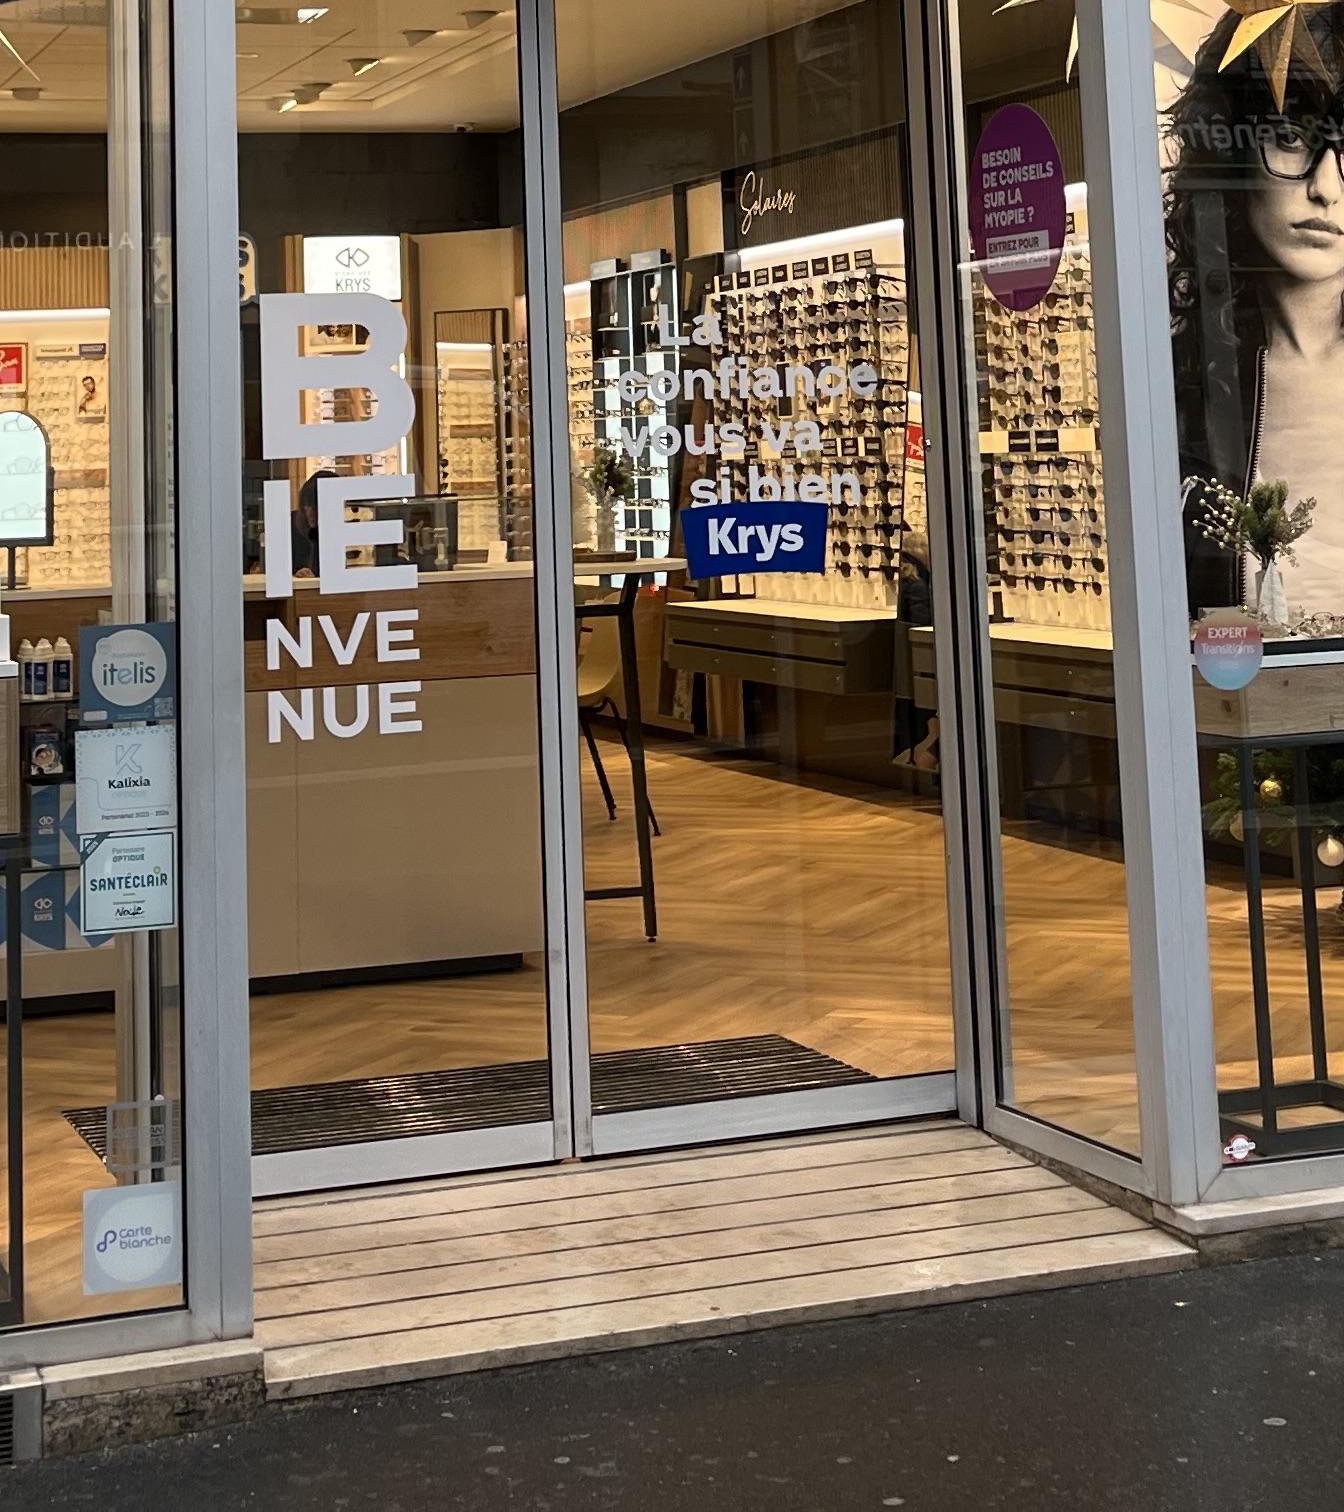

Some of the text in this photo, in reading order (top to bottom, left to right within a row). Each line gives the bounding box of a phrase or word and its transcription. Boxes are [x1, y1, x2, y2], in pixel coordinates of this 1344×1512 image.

[982, 146, 1021, 168] BESOIN
[983, 161, 1054, 188] DE CONSEILS
[984, 188, 1022, 208] SUR LA
[985, 207, 1025, 229] MYOPIE
[1018, 236, 1039, 248] POUR
[336, 278, 371, 292] KRYS
[659, 303, 723, 346] La
[618, 357, 878, 402] confiance
[620, 419, 823, 457] vous va
[690, 464, 861, 508] si bien
[708, 517, 804, 562] Krys
[266, 609, 421, 671] NVE
[1208, 627, 1248, 638] EXPERT
[103, 661, 155, 686] itelis
[268, 680, 423, 743] NUE
[108, 776, 151, 789] Kalixia
[120, 1235, 171, 1250] blanche
